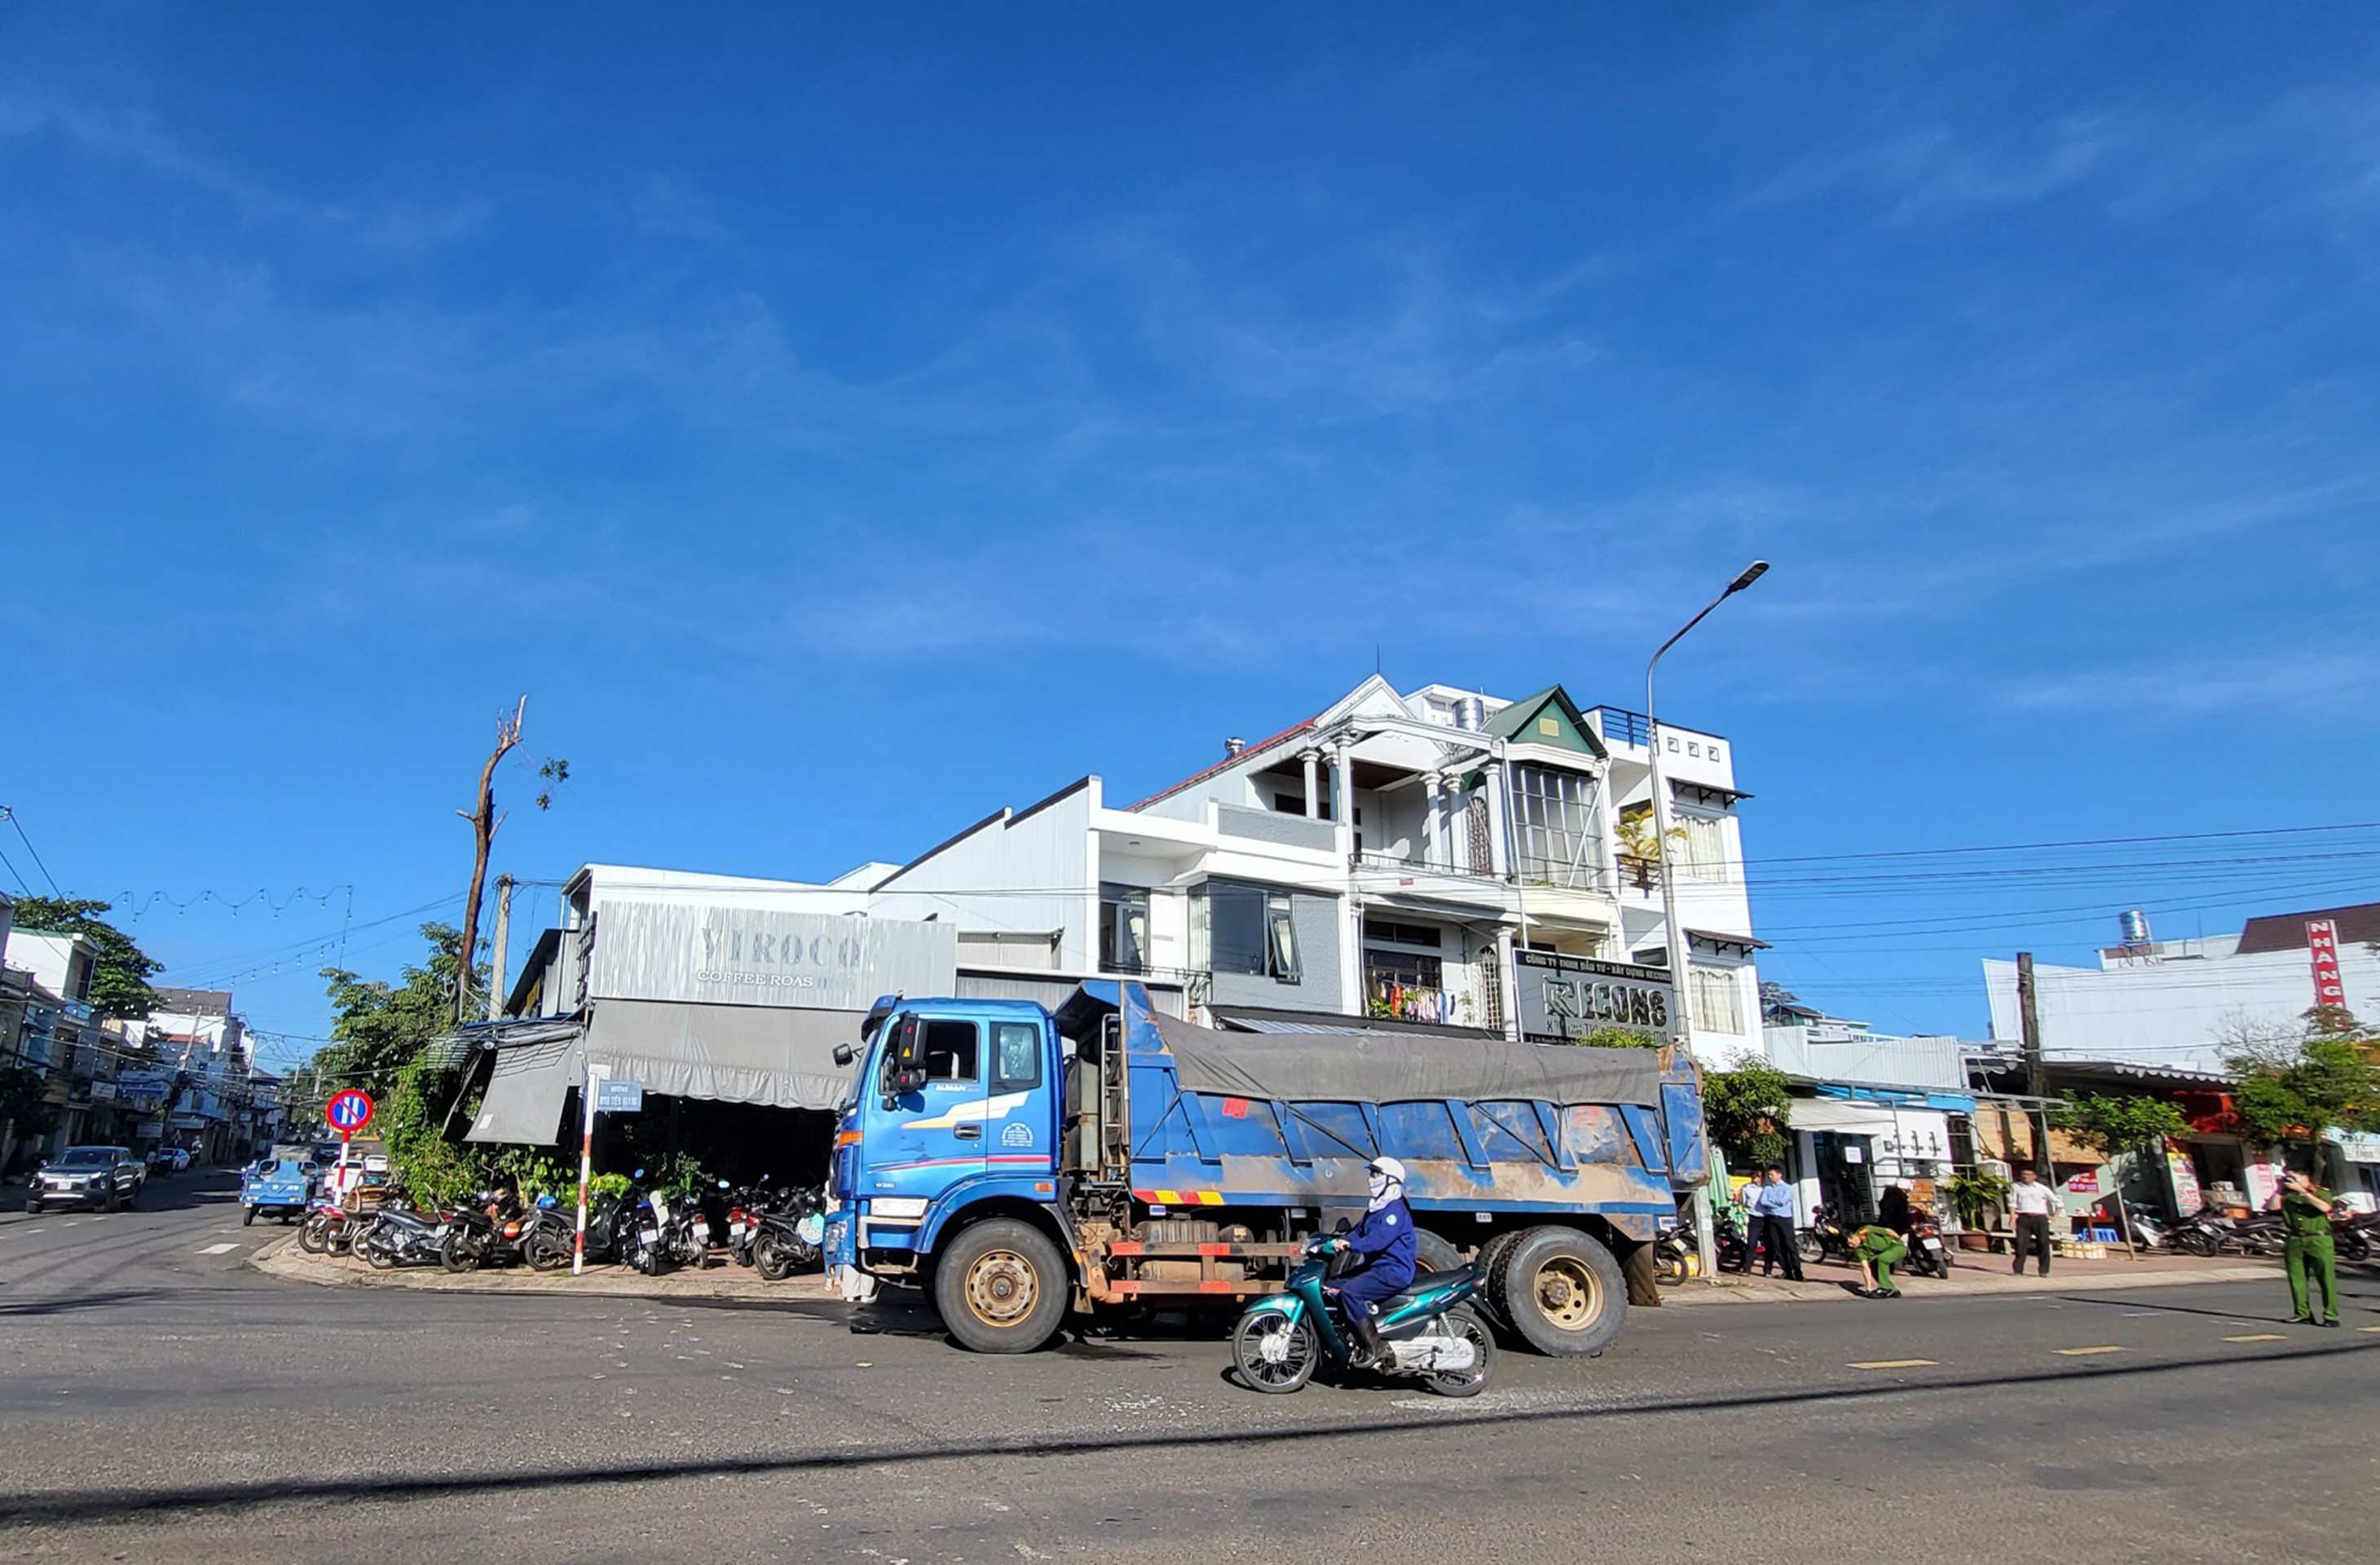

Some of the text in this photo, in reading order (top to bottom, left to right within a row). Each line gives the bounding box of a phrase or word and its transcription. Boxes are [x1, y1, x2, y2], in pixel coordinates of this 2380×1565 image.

[701, 928, 861, 968] VIROCO
[1547, 958, 1557, 967] TY
[698, 970, 766, 985] COFFEE
